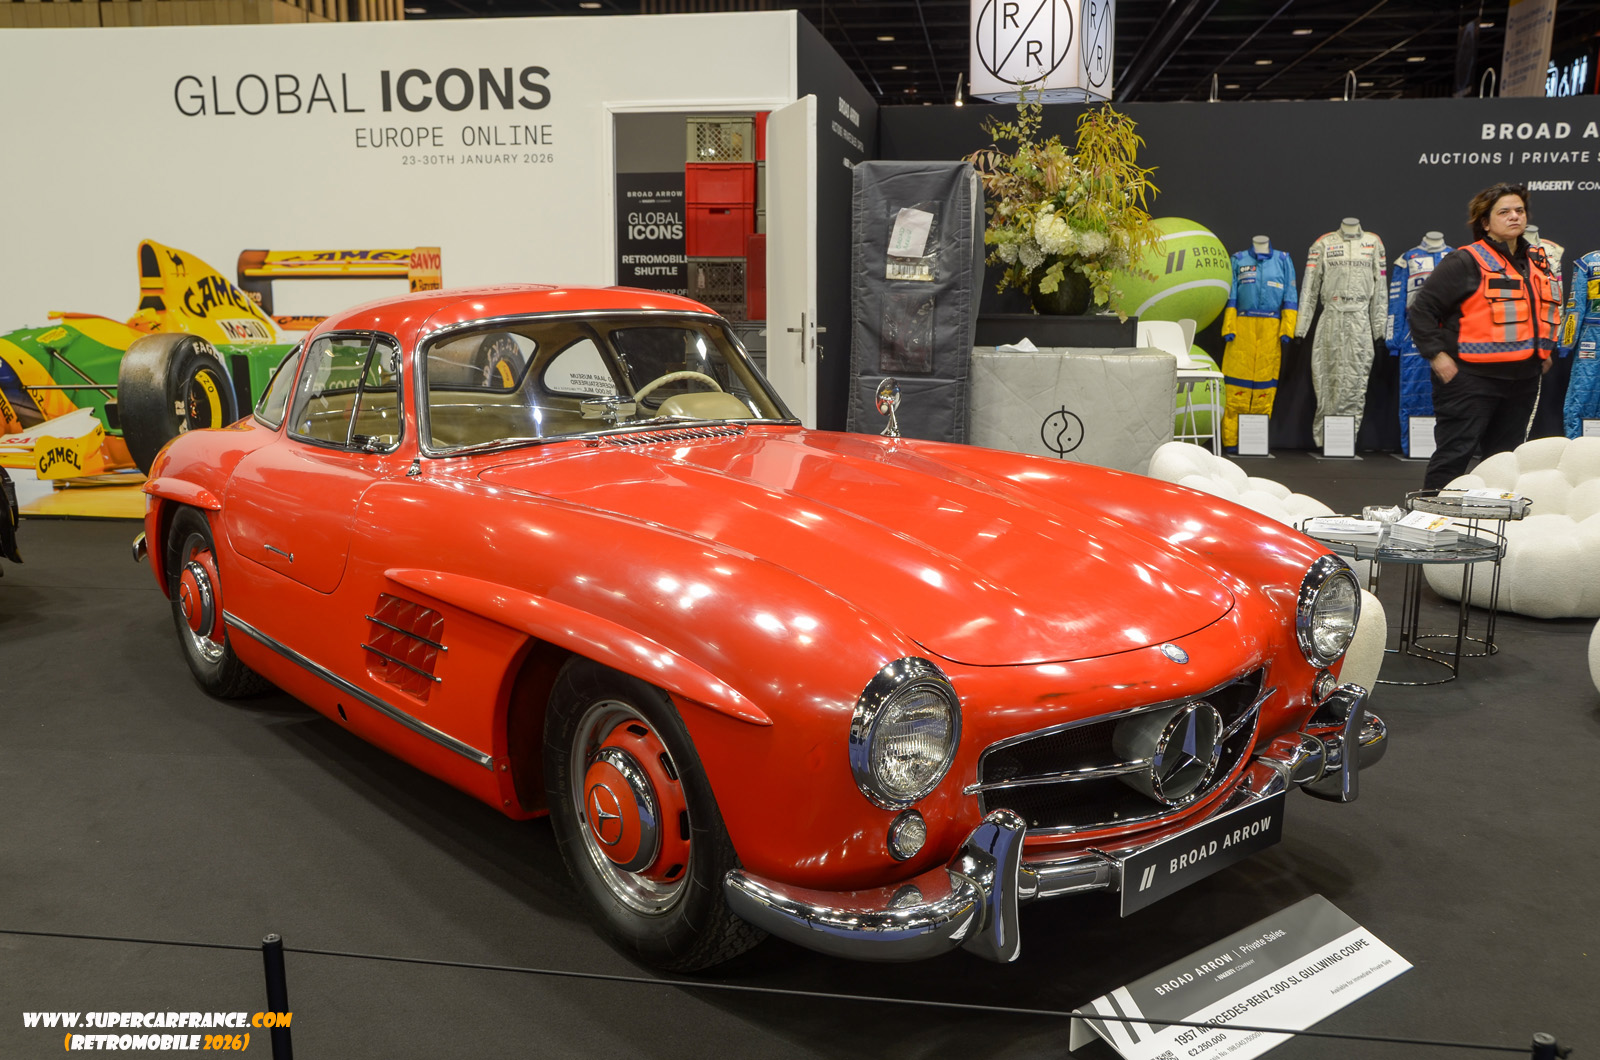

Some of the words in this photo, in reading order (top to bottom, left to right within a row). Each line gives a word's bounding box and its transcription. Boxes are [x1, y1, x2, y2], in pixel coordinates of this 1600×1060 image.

[174, 73, 366, 117] GLOBAL
[380, 66, 552, 113] ICONS
[355, 126, 444, 148] EUROPE
[461, 124, 554, 146] ONLINE
[1481, 122, 1572, 140] BROAD
[402, 154, 455, 166] 23-30TH
[460, 154, 518, 165] JANUARY
[523, 153, 554, 164] 2026
[1418, 152, 1503, 165] AUCTIONS
[1521, 151, 1590, 164] PRIVATE
[1527, 180, 1575, 192] HAGERTY
[628, 212, 683, 225] GLOBAL
[628, 225, 683, 240] ICONS
[1192, 246, 1228, 259] BROAD
[410, 253, 440, 270] SANYO
[1196, 258, 1230, 270] ARROW
[634, 266, 678, 276] SHUTTLE
[39, 447, 82, 474] CAMEL
[1170, 840, 1218, 874] BROAD
[1222, 816, 1272, 850] ARROW
[1154, 973, 1194, 996] BROAD
[1194, 953, 1234, 977] ARROW
[1239, 938, 1266, 954] Private
[1174, 1028, 1198, 1046] 1957
[1270, 980, 1291, 996] 300
[1288, 974, 1303, 986] SL
[1298, 952, 1344, 980] GULLWING
[1340, 938, 1370, 958] COUPE
[1188, 1033, 1227, 1057] €2.250.000
